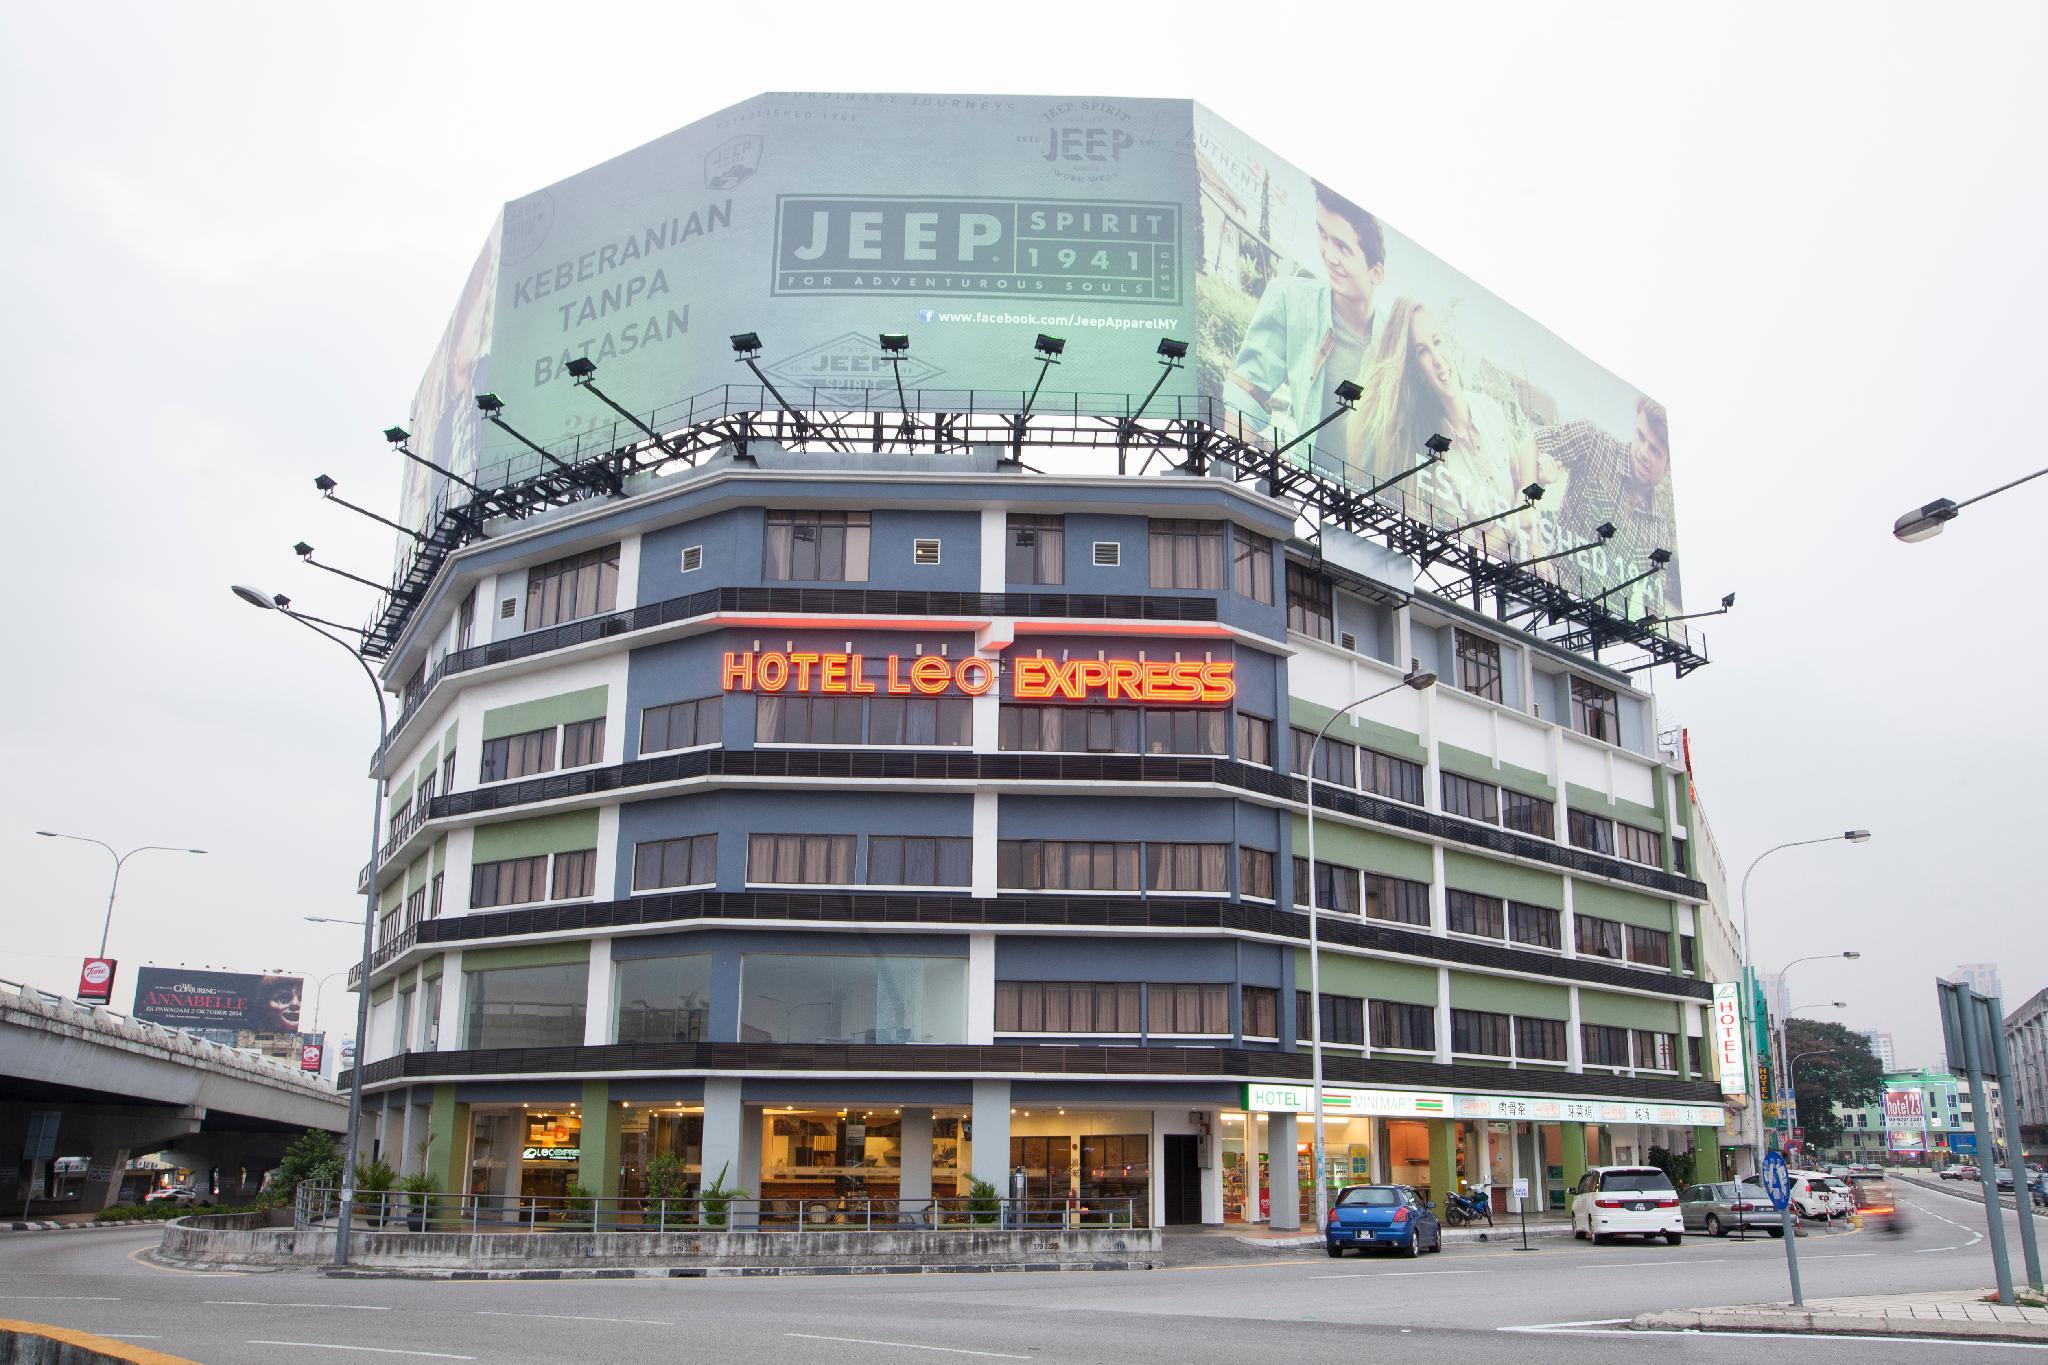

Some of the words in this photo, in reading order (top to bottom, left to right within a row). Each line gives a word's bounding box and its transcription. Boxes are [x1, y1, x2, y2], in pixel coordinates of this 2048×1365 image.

[1081, 100, 1131, 122] SPIRIT
[1041, 126, 1134, 162] JEEP
[793, 211, 1002, 262] JEEP
[1030, 211, 1162, 234] SPIRIT
[513, 198, 733, 309] KEBERANIAN
[1028, 248, 1138, 271] 1941
[788, 276, 832, 286] FOR
[854, 276, 1043, 290] ADVENTUROUS
[1065, 282, 1143, 294] SOULS
[1160, 251, 1170, 292] ESTD
[558, 268, 671, 332] TANPA
[938, 311, 1178, 331] www.facebook.com/JeepApparelMY
[533, 304, 691, 388] BATASAN
[811, 355, 892, 372] JEEP
[722, 652, 875, 694] HOTEL
[1014, 658, 1236, 702] EXPRESS
[143, 991, 247, 1009] ANNABELLE
[1720, 1001, 1736, 1064] HOTEL
[1256, 1090, 1301, 1107] HOTEL
[1759, 1067, 1769, 1100] HOTEL
